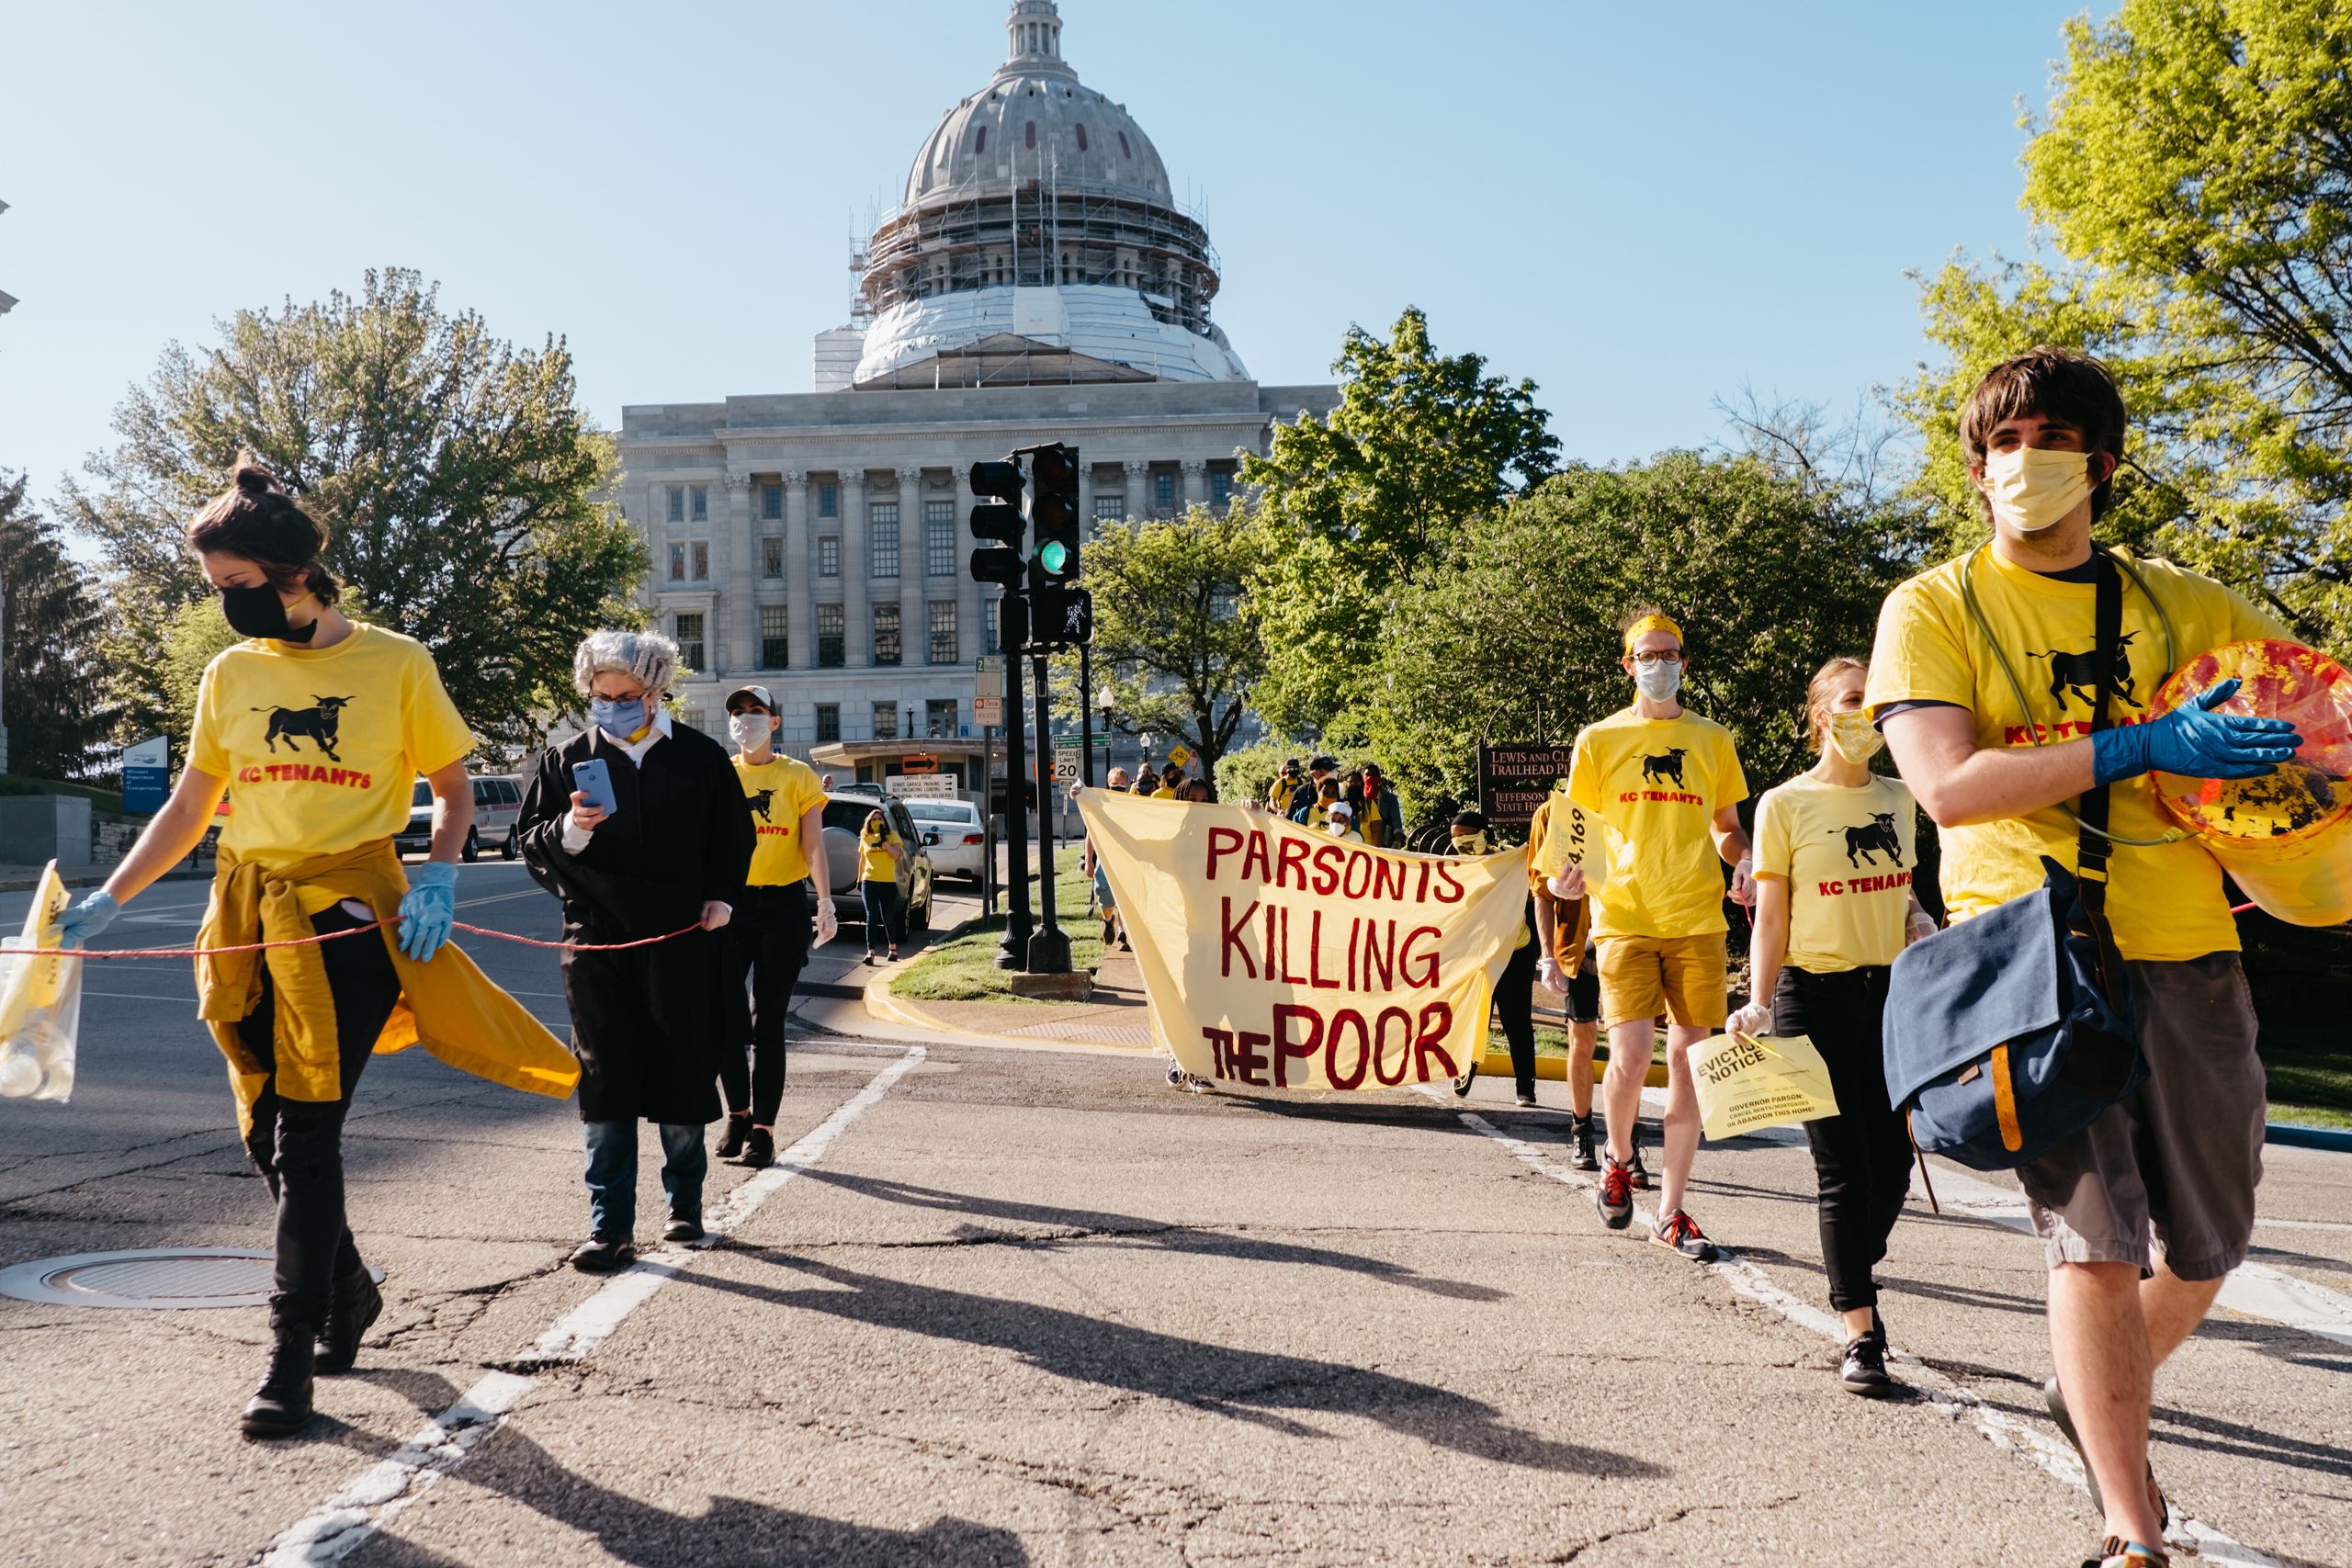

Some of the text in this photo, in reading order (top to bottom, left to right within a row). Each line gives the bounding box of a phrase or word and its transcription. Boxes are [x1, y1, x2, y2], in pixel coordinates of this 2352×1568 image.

[978, 660, 983, 671] 2
[2005, 724, 2047, 744] KC
[1491, 751, 1526, 763] LEWIS
[1529, 753, 1550, 762] AND
[239, 763, 371, 789] KC TENANTS
[1058, 764, 1076, 776] 20
[1489, 764, 1554, 776] TRAILHEAD
[1495, 792, 1544, 804] JEFFERSON
[1495, 802, 1522, 812] STATE
[1620, 791, 1703, 806] KC TENANTS
[1206, 827, 1465, 903] PARSON IS
[1819, 881, 1844, 897] KC
[1222, 897, 1442, 992] KILLING
[1203, 1001, 1459, 1090] THE POOR
[1709, 1050, 1766, 1084] NOTICE
[1729, 1097, 1770, 1112] GOVERNOR
[1771, 1093, 1804, 1103] PARSON:
[1729, 1100, 1809, 1120] CANCEL RENTS/MORTGAGES
[1736, 1113, 1773, 1125] ABANDON
[1792, 1106, 1815, 1114] HOME!
